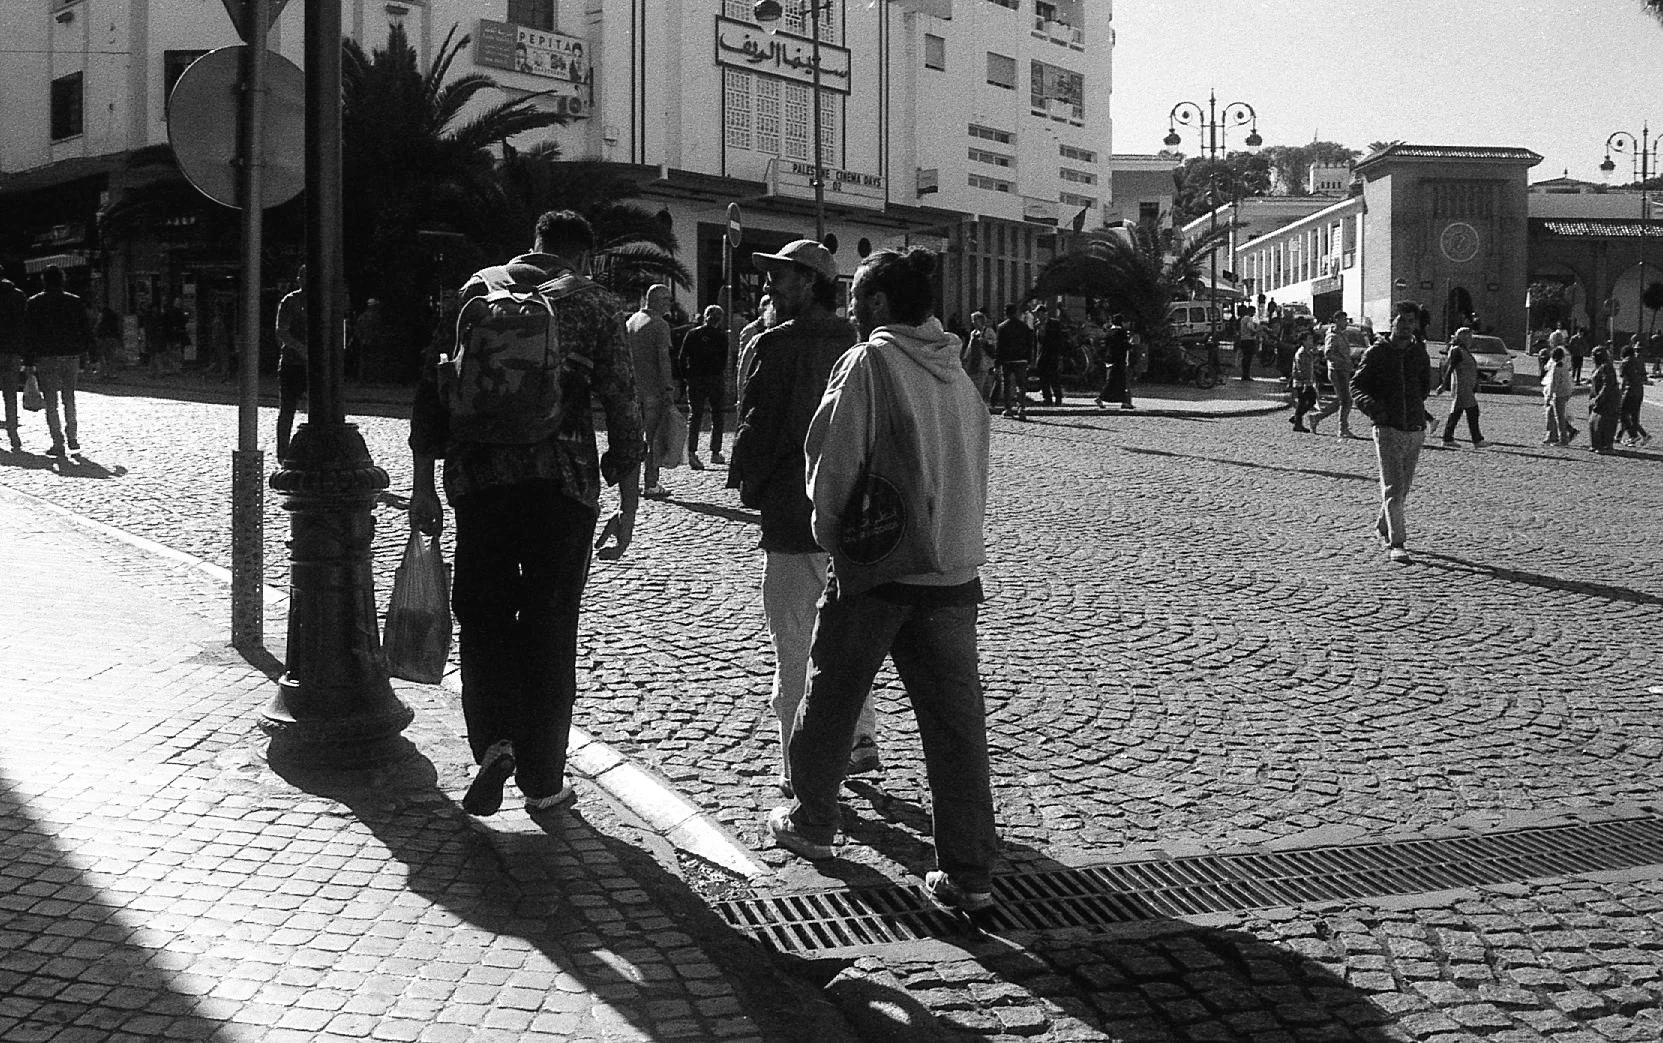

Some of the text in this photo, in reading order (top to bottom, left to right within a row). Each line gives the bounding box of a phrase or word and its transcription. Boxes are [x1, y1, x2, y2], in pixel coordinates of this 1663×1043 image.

[520, 32, 571, 52] PEPITA
[783, 43, 848, 78] سينما
[793, 163, 830, 179] PALESNE
[836, 170, 861, 184] CINEMA
[863, 175, 881, 188] DAYS
